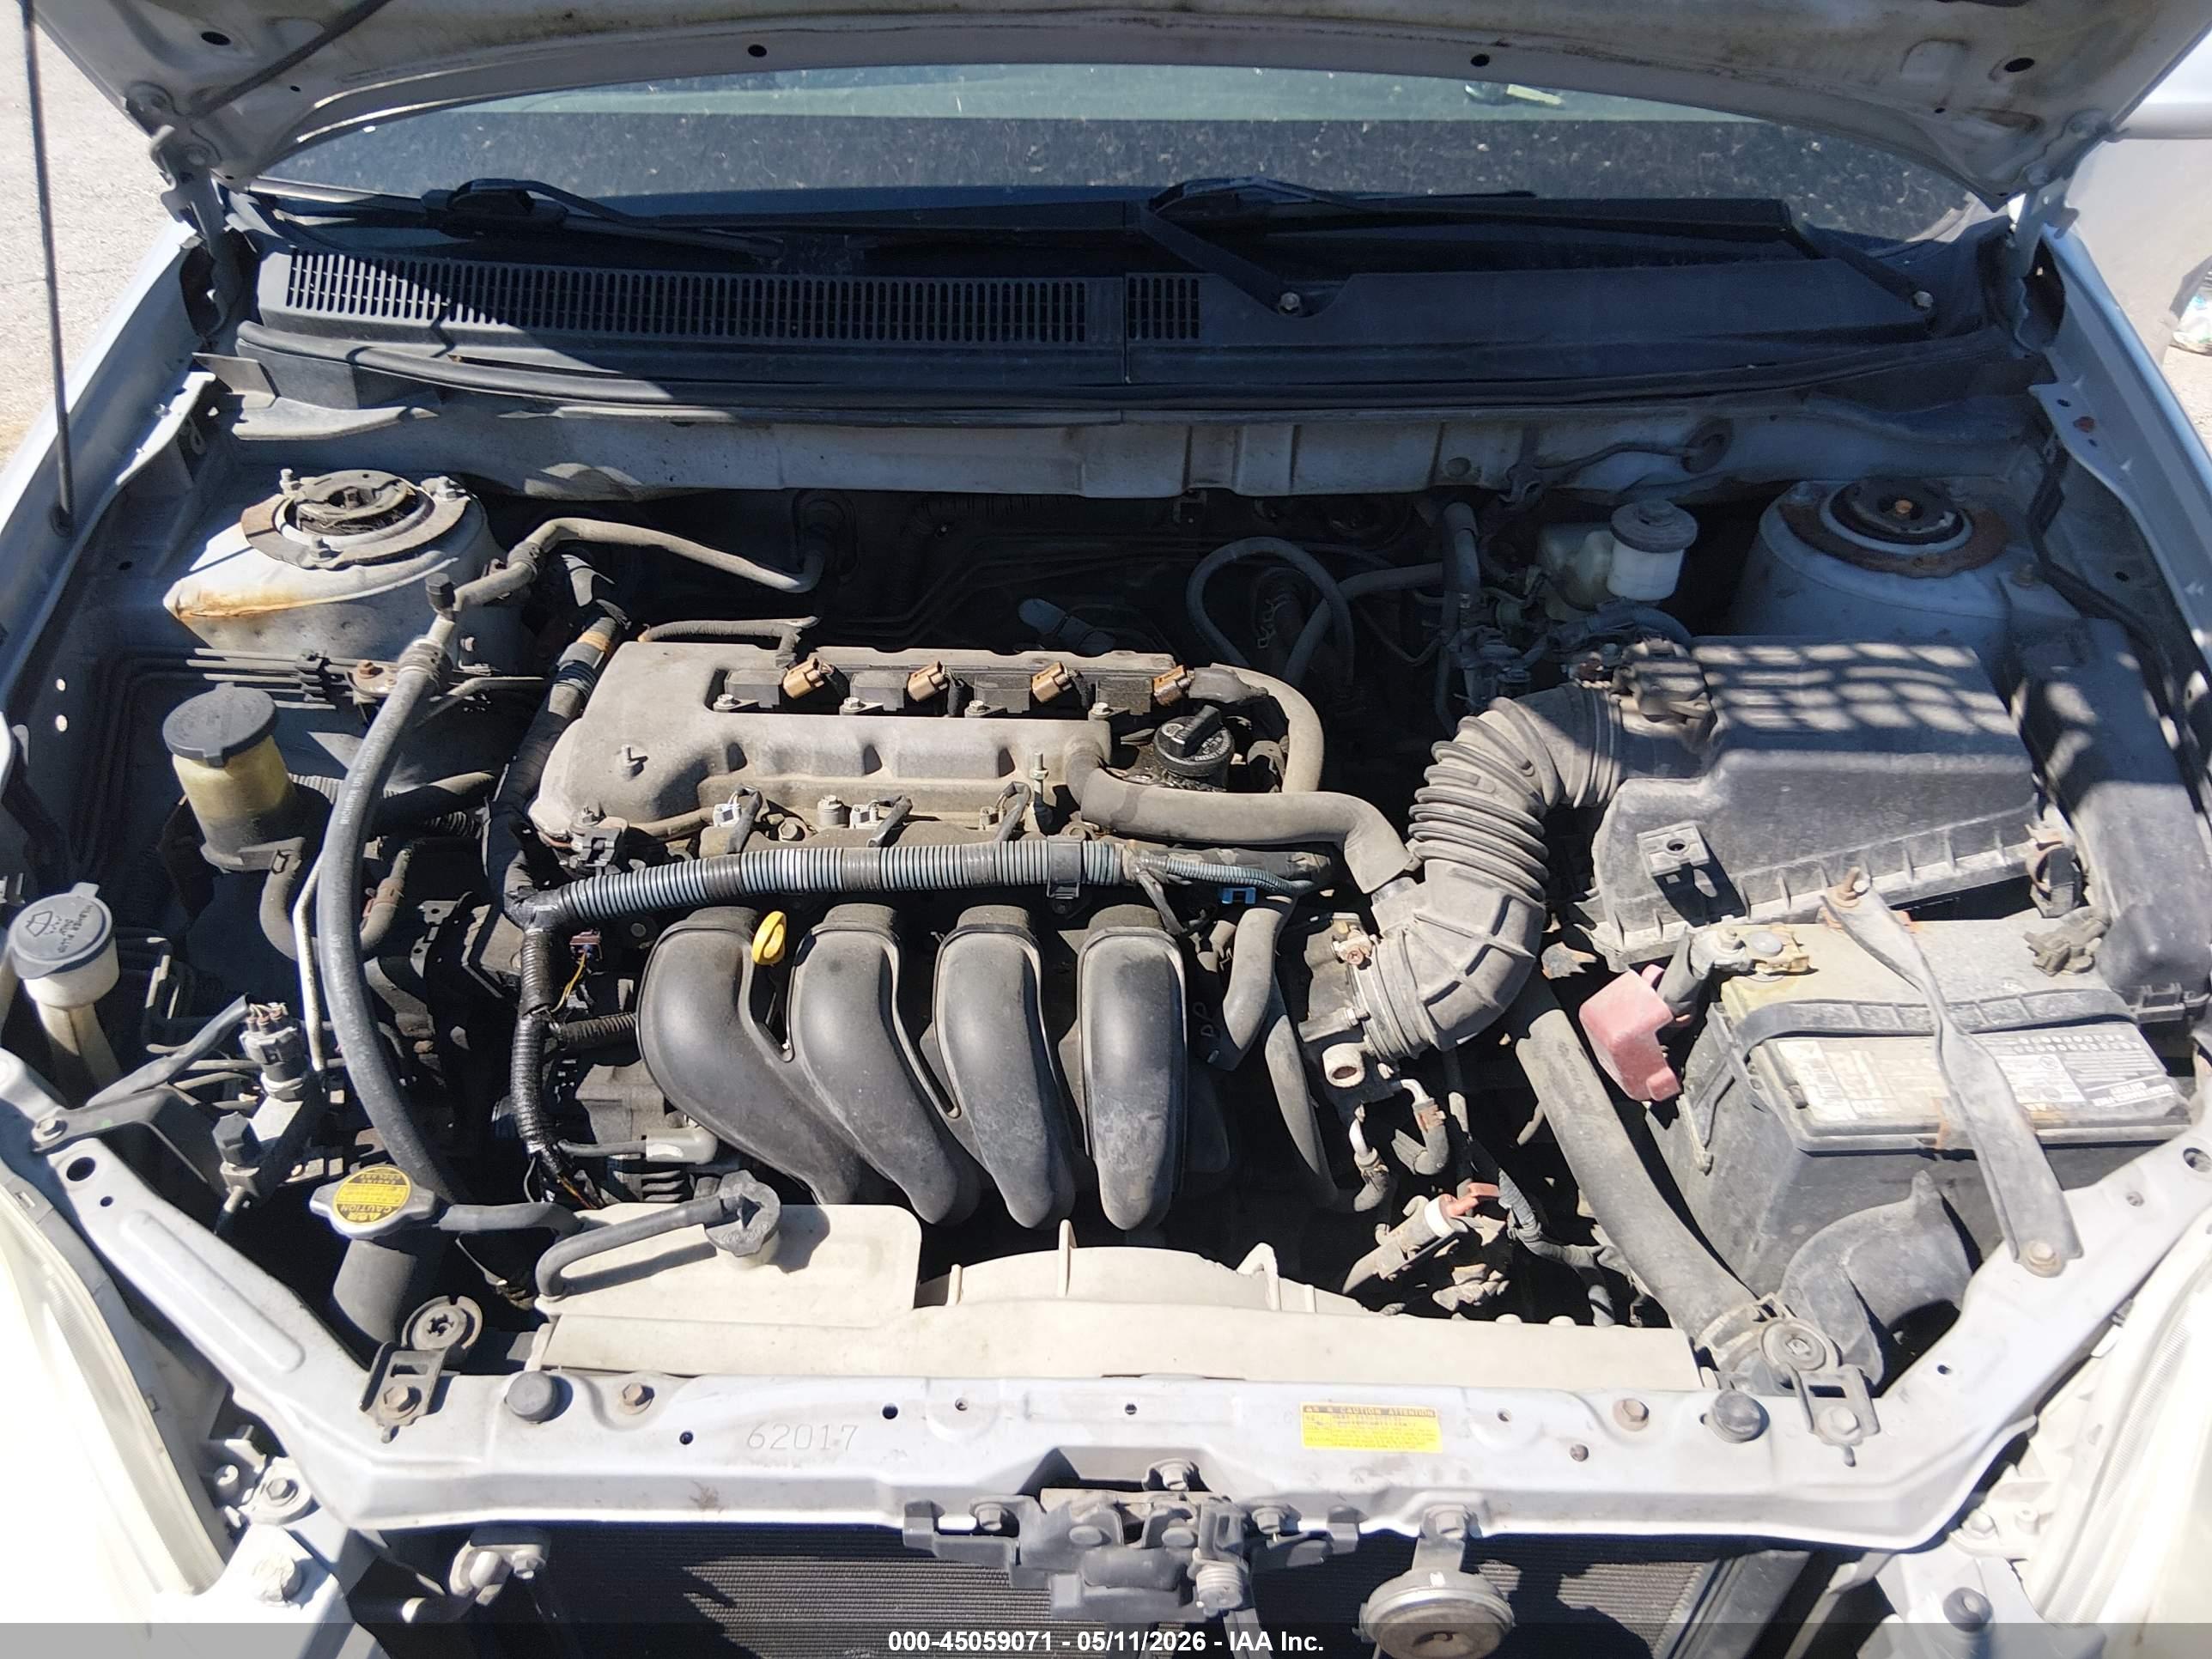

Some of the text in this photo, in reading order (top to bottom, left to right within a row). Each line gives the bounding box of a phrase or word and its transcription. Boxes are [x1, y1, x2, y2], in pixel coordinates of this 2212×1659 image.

[339, 1204, 392, 1213] CAUTION
[1340, 1405, 1382, 1414] CAUTION
[1388, 1407, 1436, 1417] ATTENTION
[747, 1421, 860, 1450] 62017
